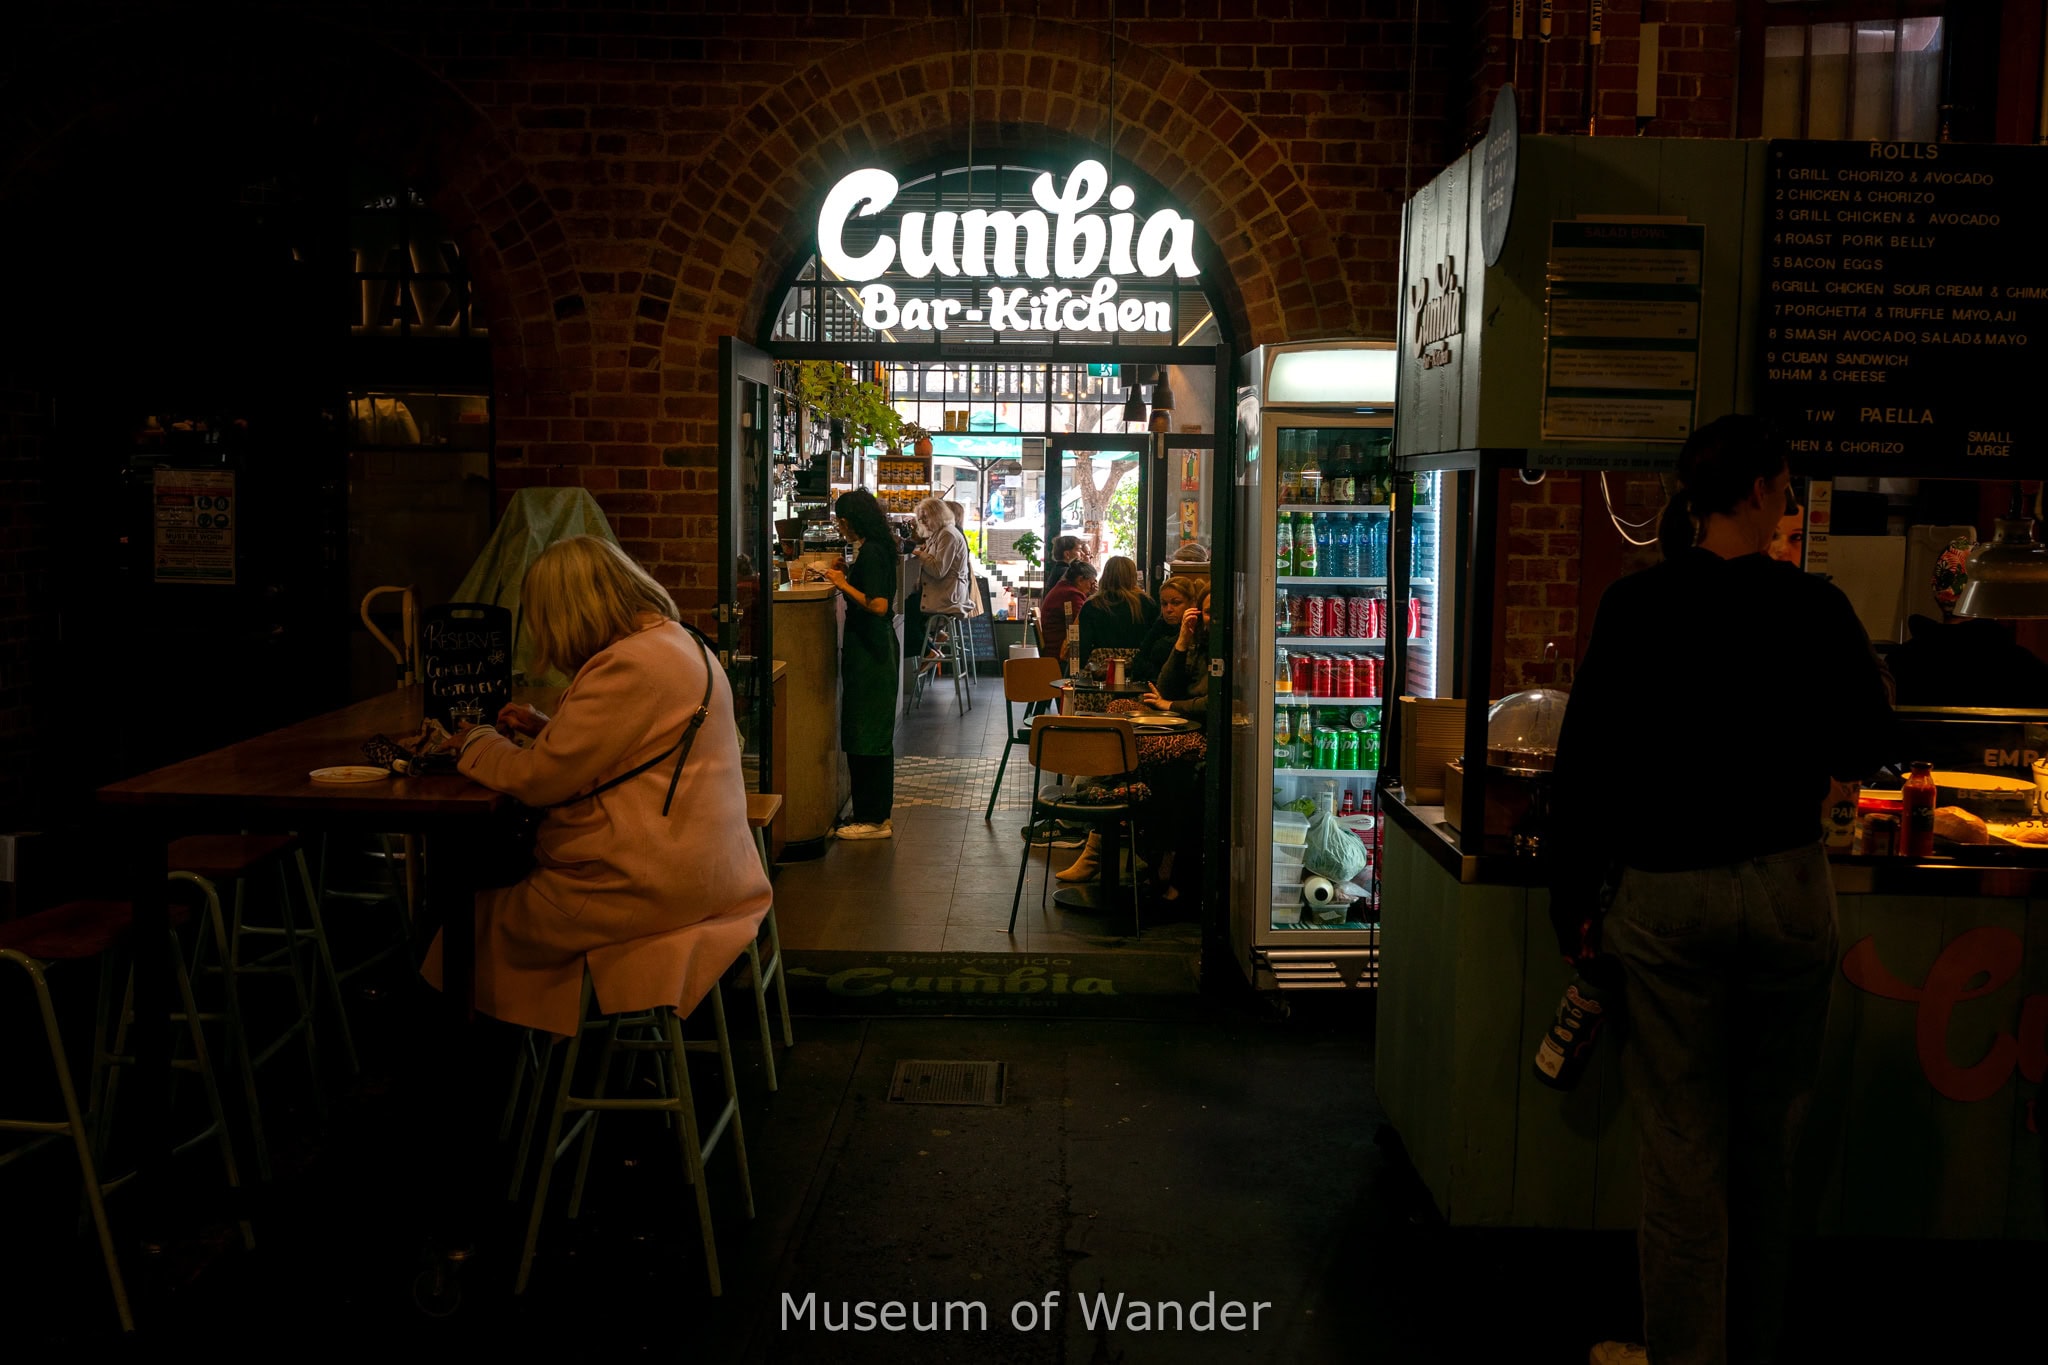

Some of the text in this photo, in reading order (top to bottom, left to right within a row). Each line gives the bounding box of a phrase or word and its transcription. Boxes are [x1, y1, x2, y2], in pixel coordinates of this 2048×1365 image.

[1869, 143, 1939, 159] ROLLS
[1789, 169, 1828, 180] GRILL
[1838, 170, 1904, 182] CHORIZO
[1924, 172, 1993, 185] AVOCADO
[1789, 189, 1849, 201] CHICKEN
[1868, 192, 1934, 203] CHORIZO
[818, 160, 1200, 281] Cumbia
[1789, 210, 1830, 221] GRILL
[1837, 211, 1901, 223] CHICKEN
[1929, 214, 2000, 225] AVOCADO
[1786, 233, 1832, 244] ROAST
[1843, 235, 1882, 246] PORK
[1891, 236, 1935, 248] BELLY
[1784, 257, 1835, 269] BACON
[1844, 259, 1883, 270] EGGS
[1826, 282, 1884, 294] CHICKEN
[1893, 284, 1930, 295] SOUR
[1936, 285, 1982, 296] CREAM
[1785, 304, 1866, 317] PORCHETTA
[1888, 307, 1944, 319] TRUFFLE
[1785, 328, 1836, 340] SMASH
[1921, 332, 1971, 344] SALAD
[1985, 334, 2027, 345] MAYO
[1782, 352, 1827, 363] CUBAN
[1836, 353, 1908, 365] SANDWICH
[1833, 370, 1886, 382] CHEESE
[1861, 408, 1933, 423] PAELLA
[1968, 432, 2013, 443] SMALL
[1786, 440, 1819, 452] HEN
[1841, 441, 1904, 453] CHORIZO
[1967, 445, 2011, 456] LARGE
[786, 966, 1120, 997] Cumbia
